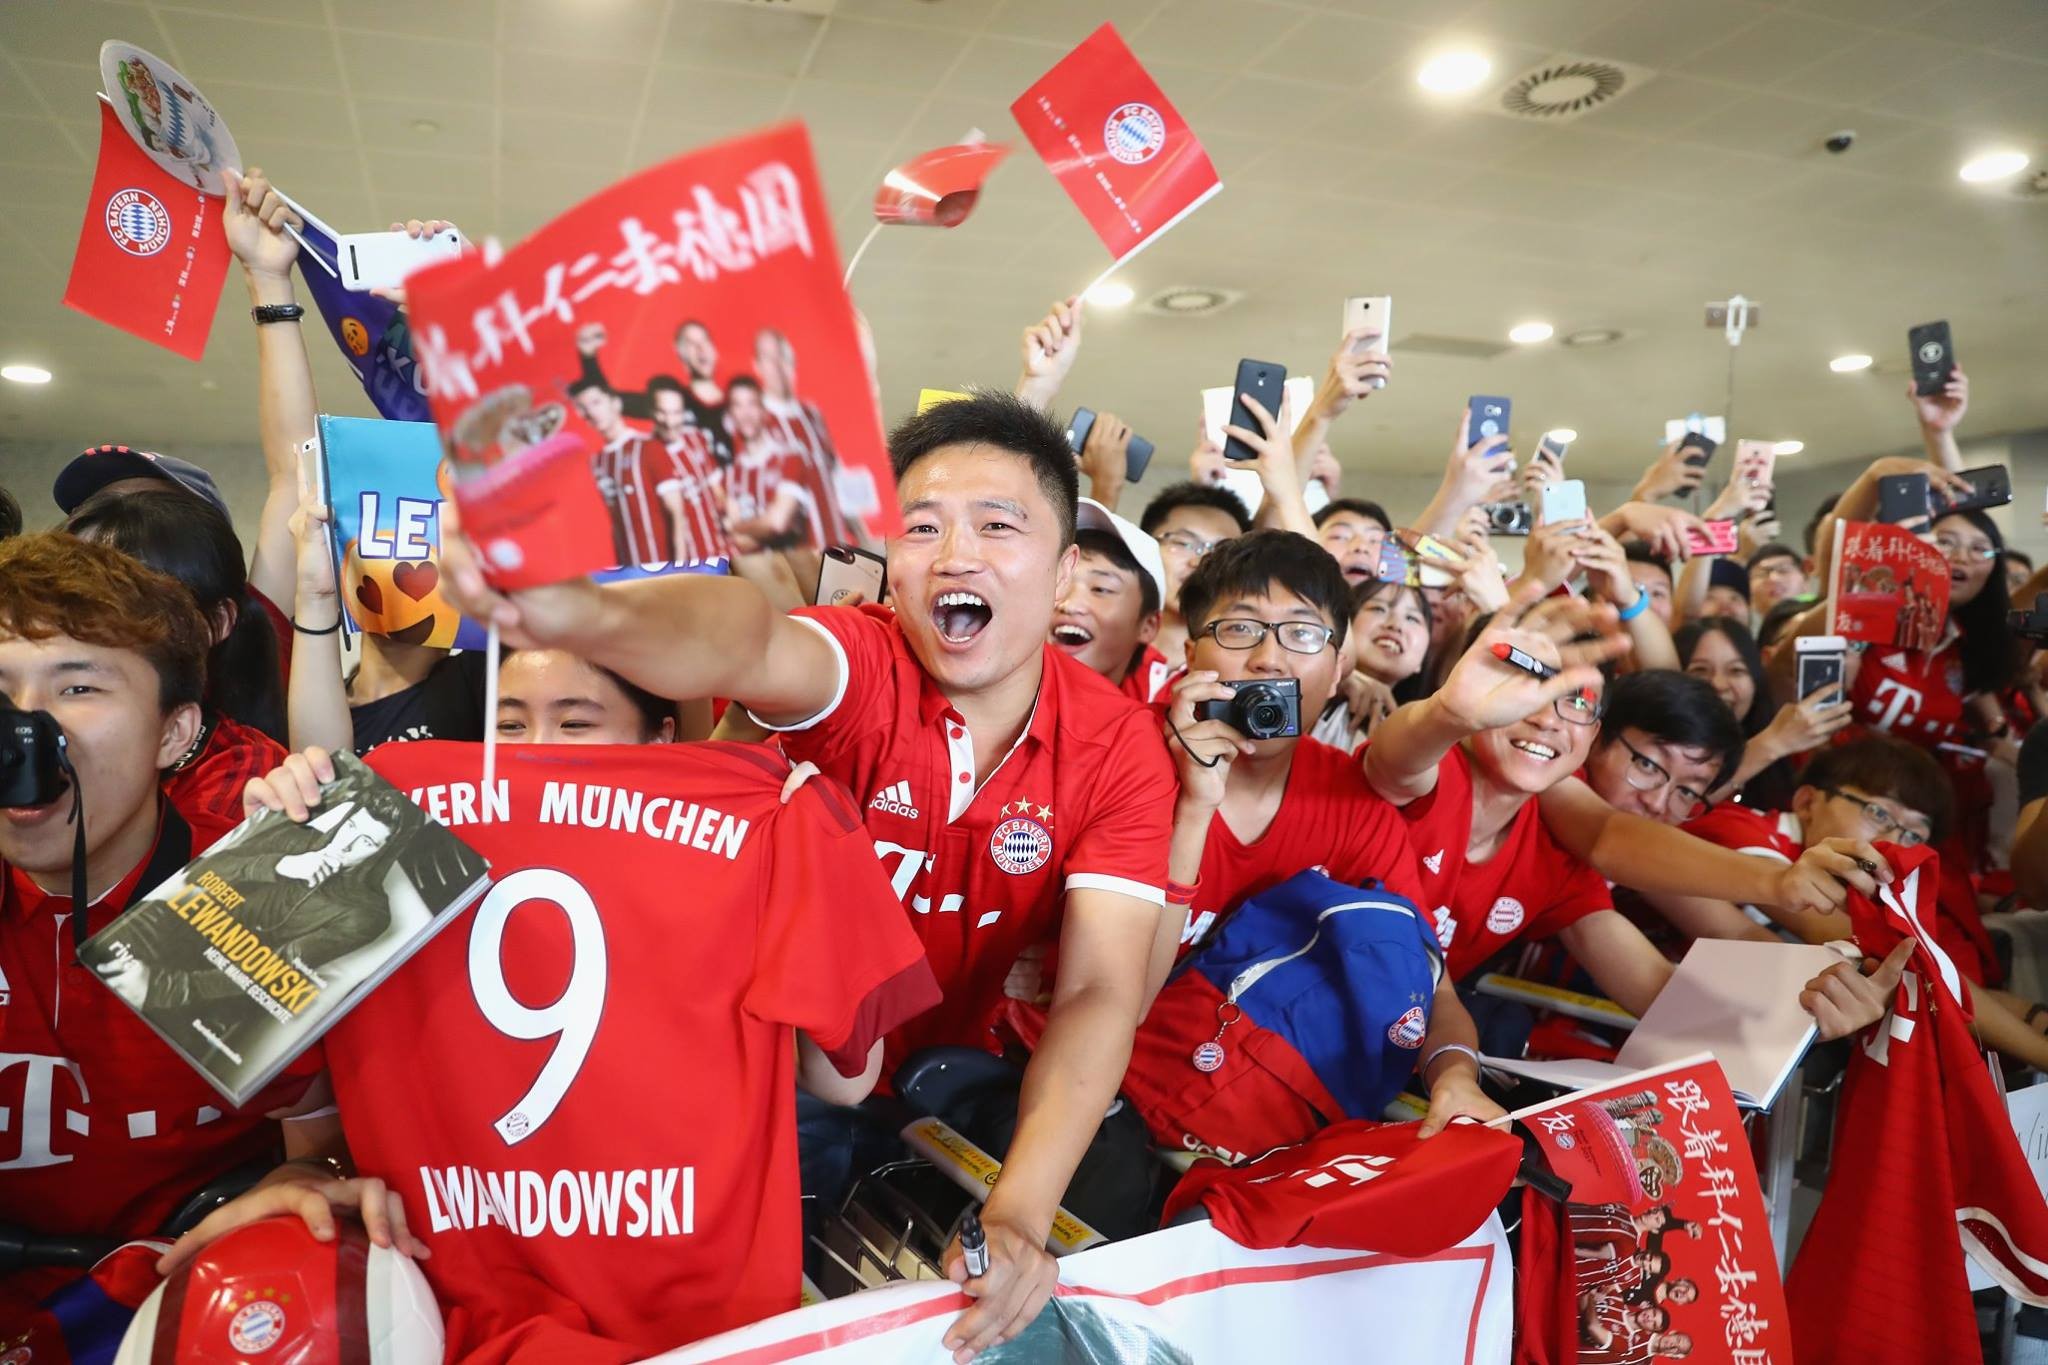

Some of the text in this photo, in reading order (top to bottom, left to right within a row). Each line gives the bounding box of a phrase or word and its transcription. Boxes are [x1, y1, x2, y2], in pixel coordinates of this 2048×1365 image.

[108, 192, 139, 246] FC BAYERN
[358, 491, 446, 560] LE
[539, 780, 750, 861] MÜNCHEN
[997, 820, 1049, 852] FC BAYERN
[197, 870, 247, 910] ROBERT
[166, 883, 320, 1015] LEWANDOWSKI
[246, 985, 294, 1023] GESCHICHTE
[468, 867, 608, 1146] 9
